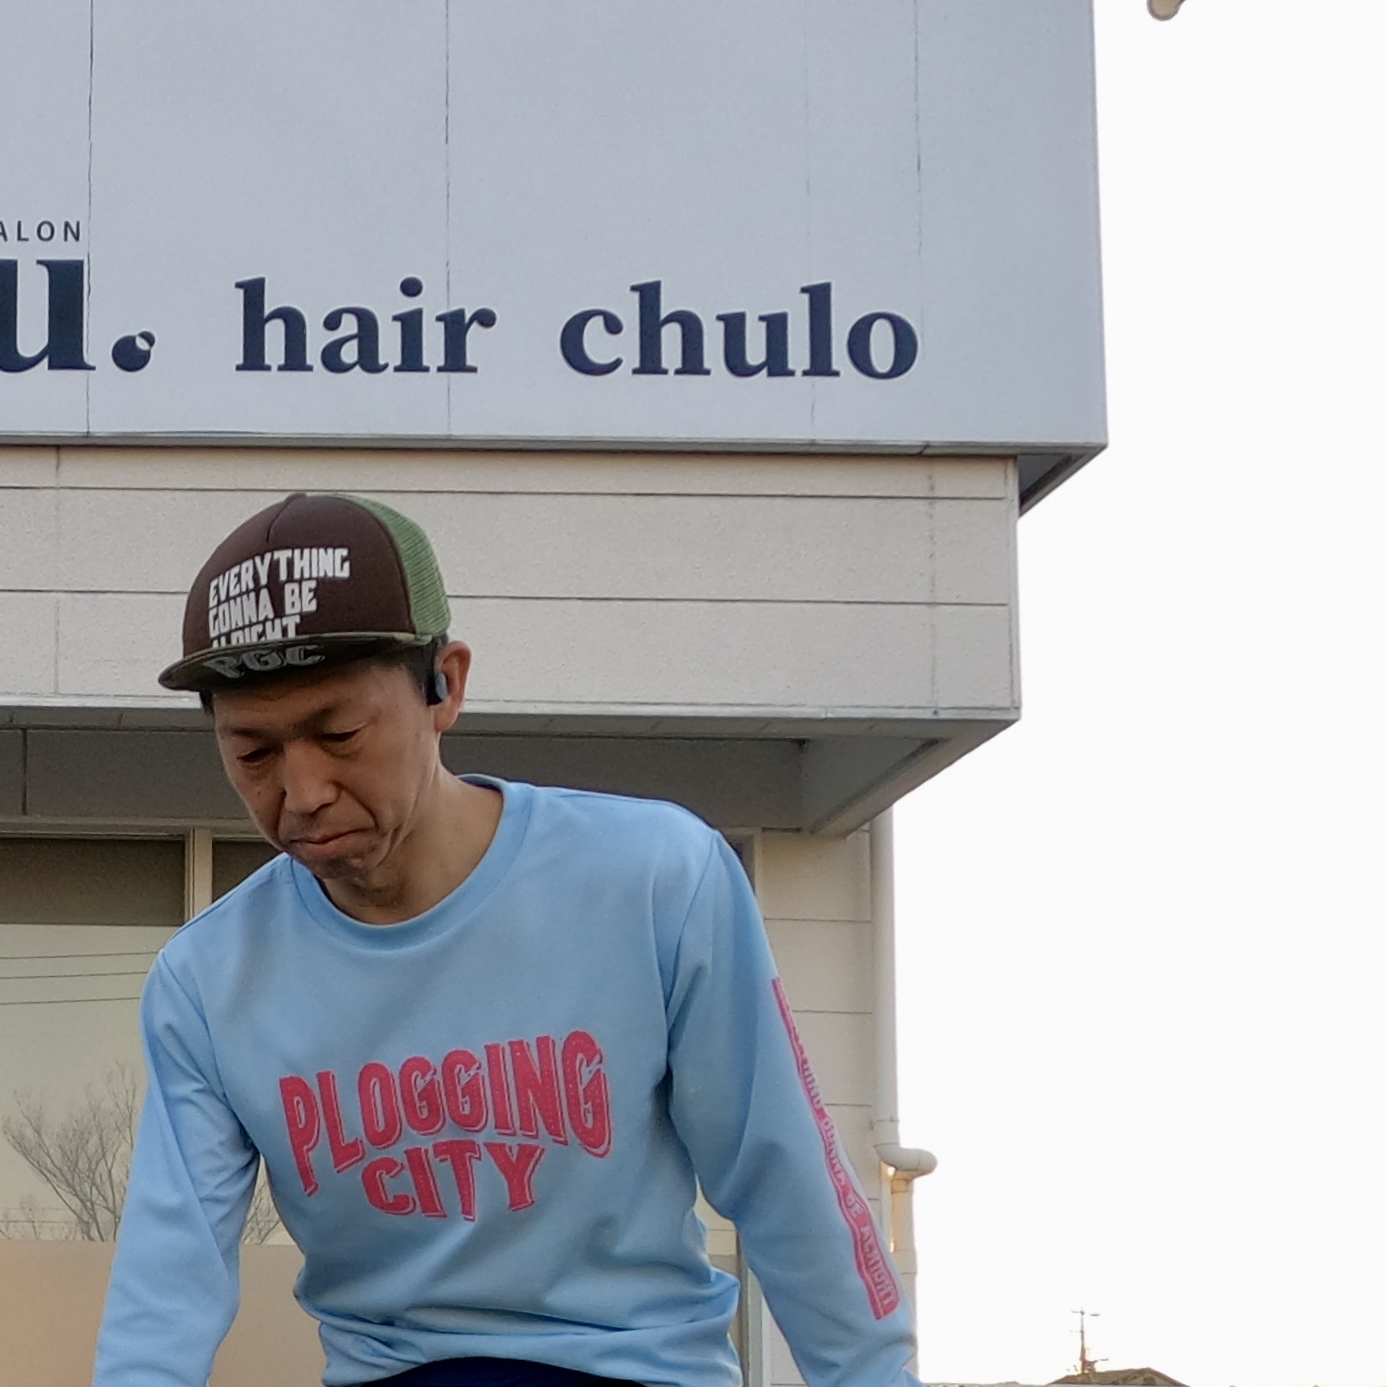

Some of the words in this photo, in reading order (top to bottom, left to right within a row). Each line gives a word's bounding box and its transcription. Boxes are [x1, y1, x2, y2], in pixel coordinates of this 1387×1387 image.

[234, 276, 497, 374] hair
[559, 280, 919, 380] chulo
[208, 586, 275, 640] GONNA
[284, 580, 318, 614] BE
[209, 548, 351, 608] EVERYTHING
[279, 1029, 612, 1197] PLOGGING
[361, 1139, 545, 1222] CITY
